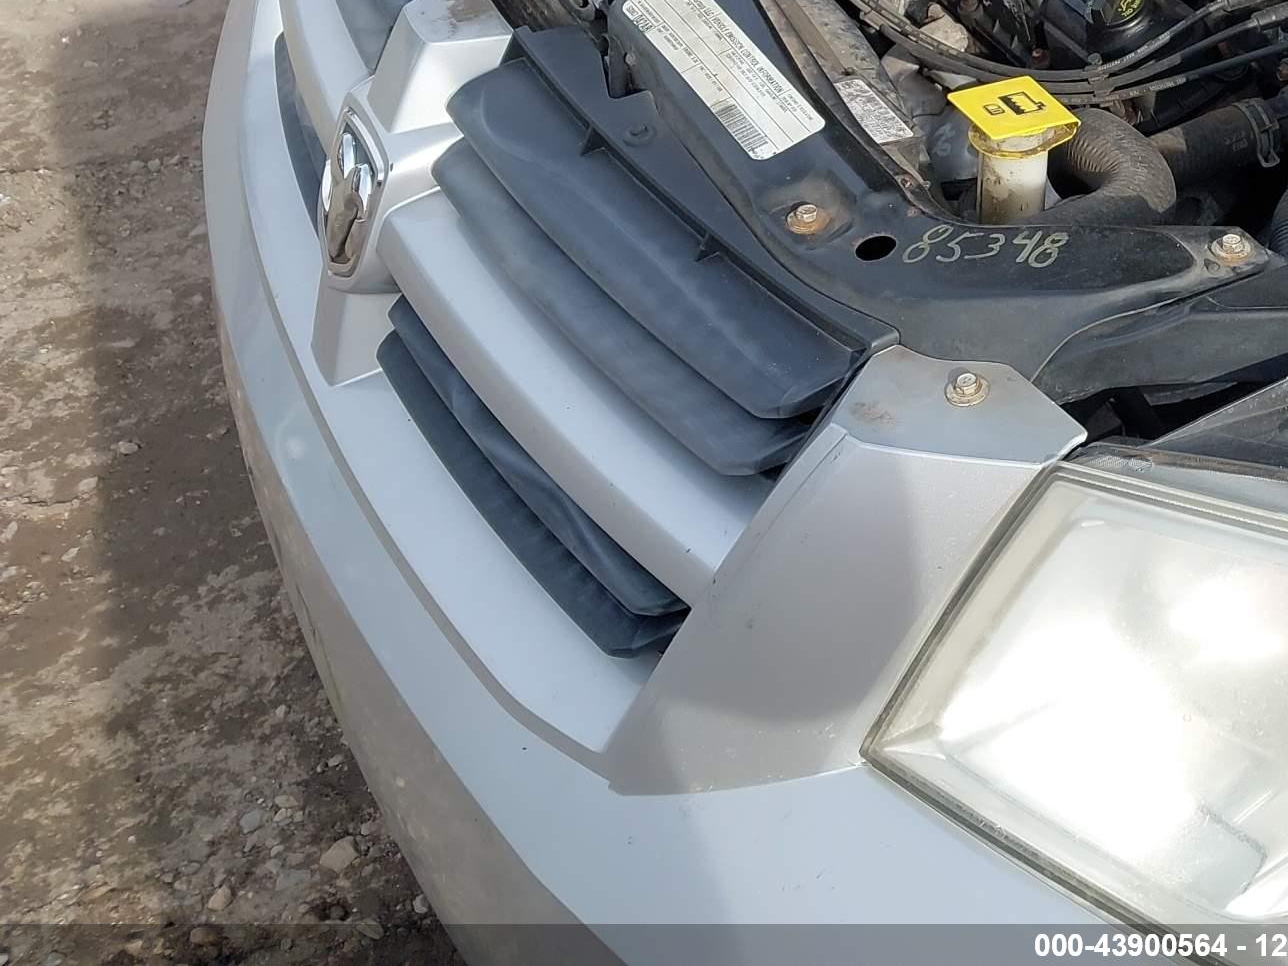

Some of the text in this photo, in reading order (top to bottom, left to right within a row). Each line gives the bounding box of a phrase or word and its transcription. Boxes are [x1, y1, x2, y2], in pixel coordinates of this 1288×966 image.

[702, 6, 715, 17] LLC
[739, 47, 761, 67] CONTROL
[754, 64, 785, 94] INFORMATION
[902, 223, 1070, 268] 85348
